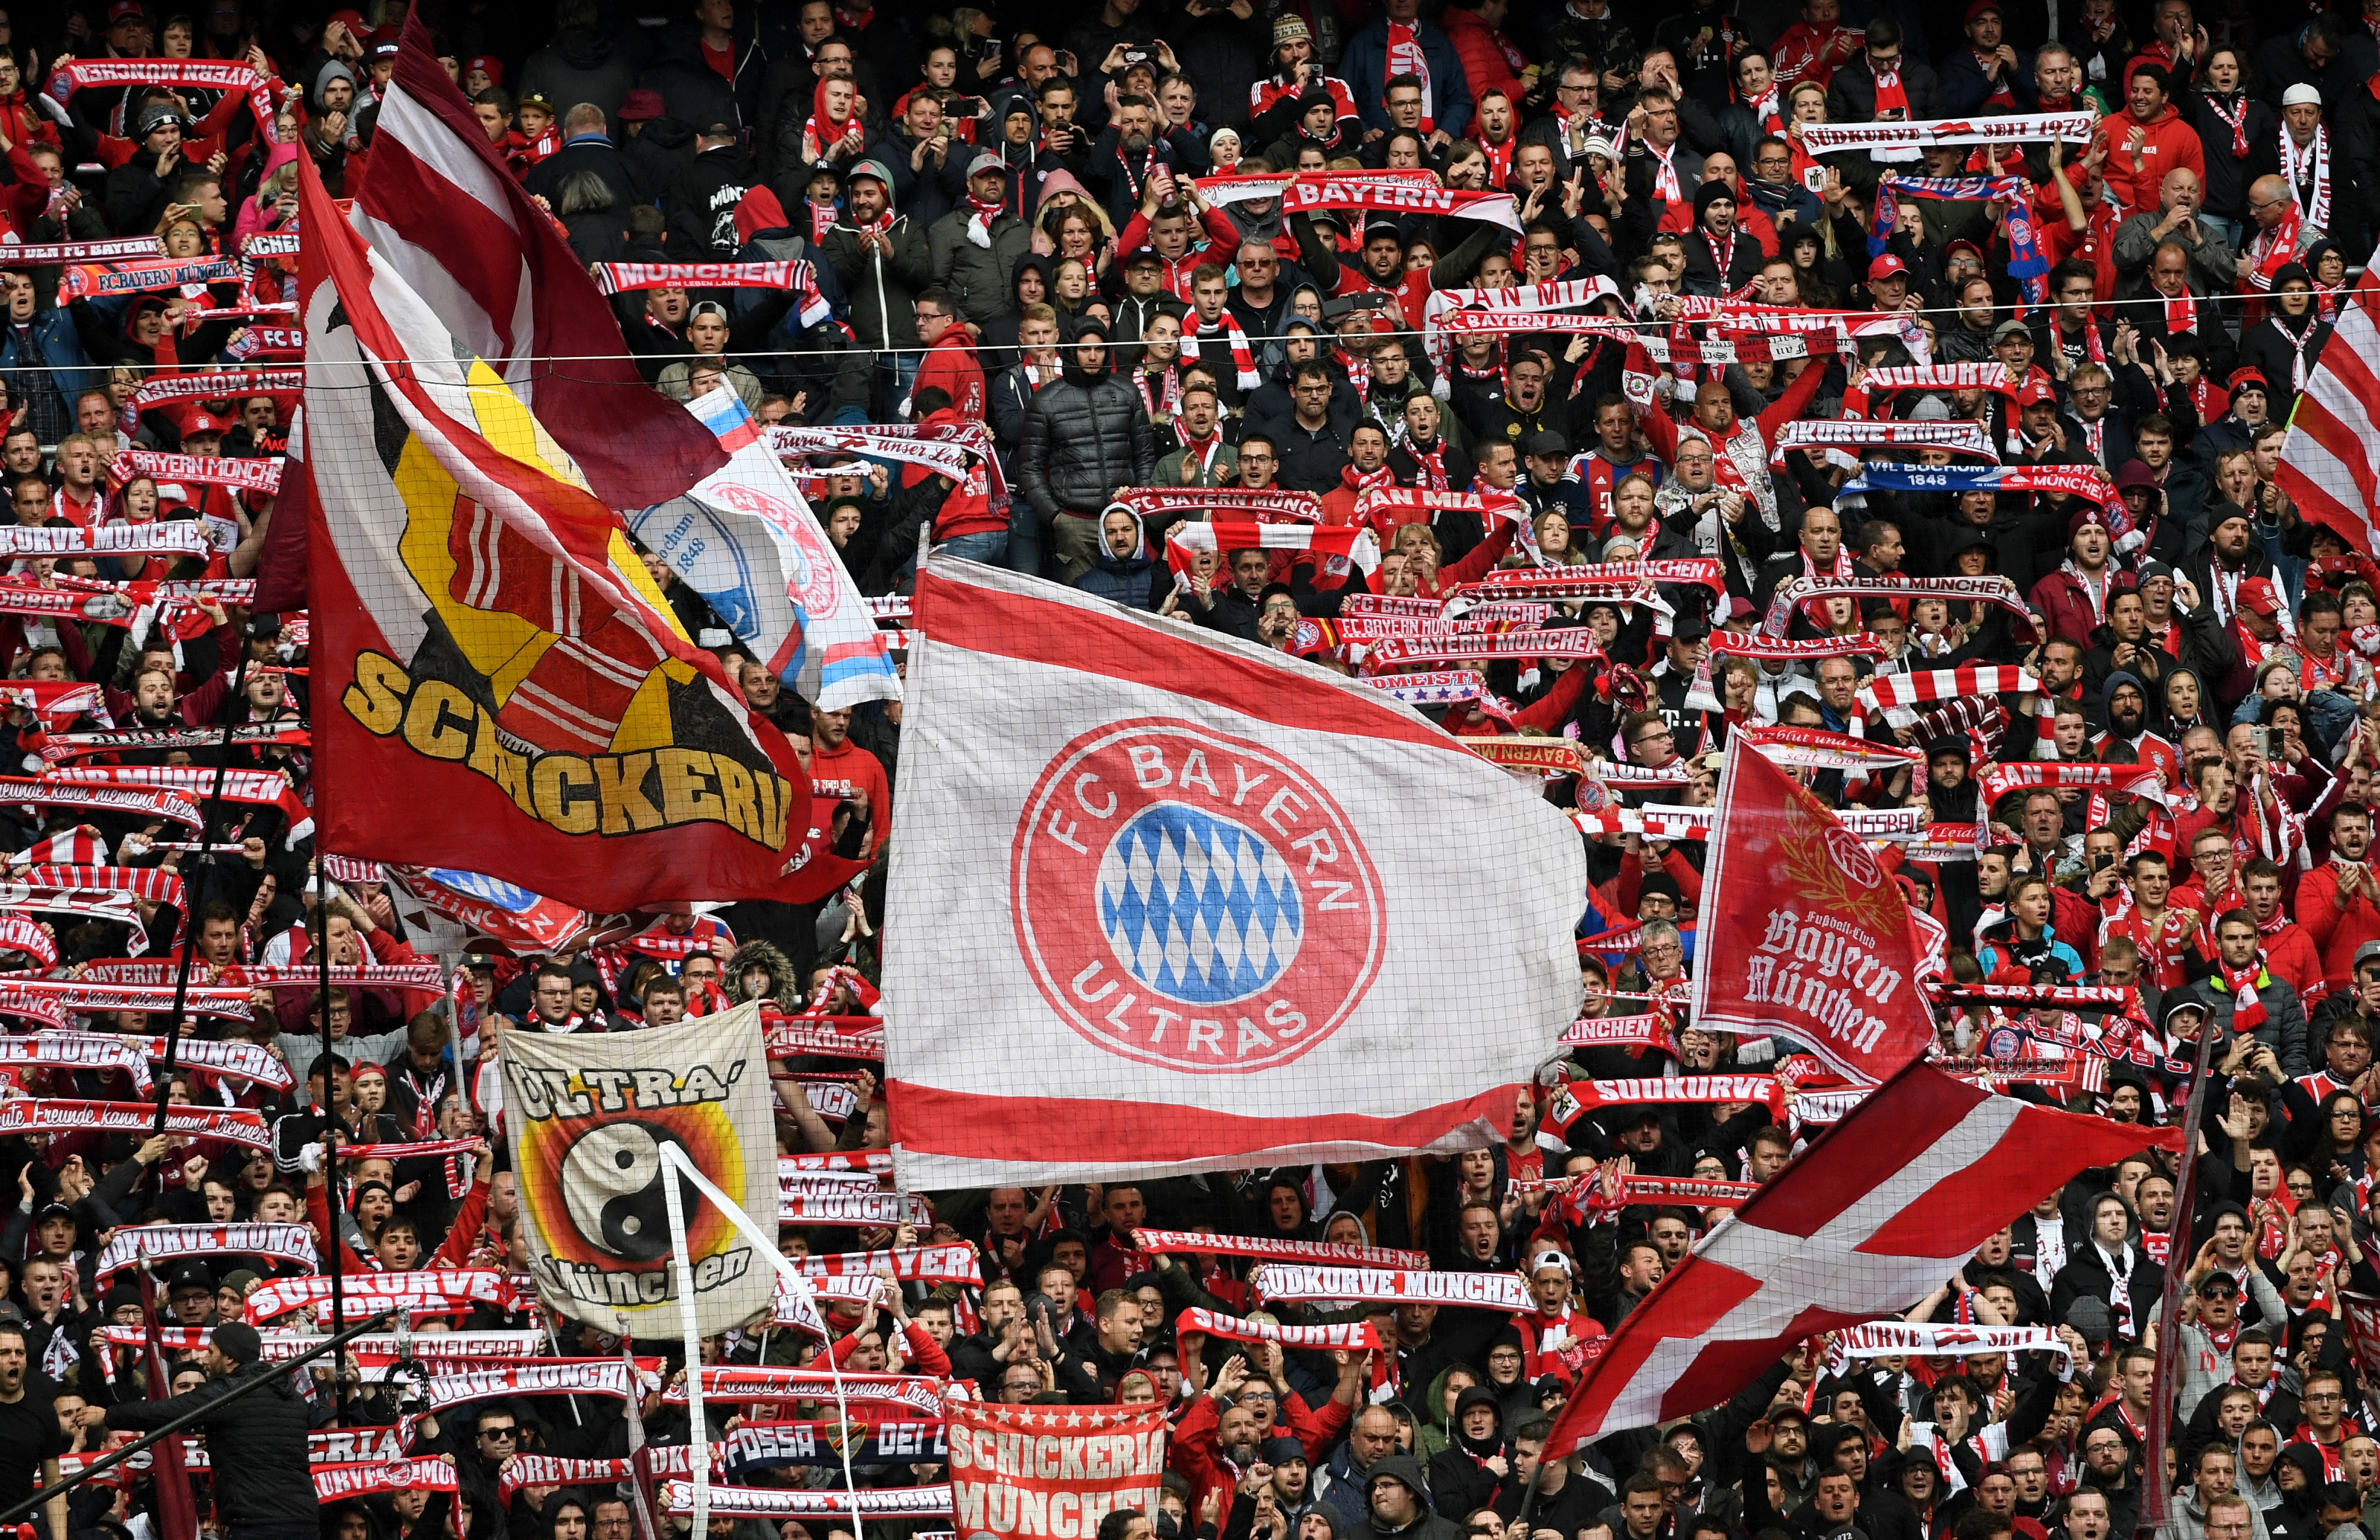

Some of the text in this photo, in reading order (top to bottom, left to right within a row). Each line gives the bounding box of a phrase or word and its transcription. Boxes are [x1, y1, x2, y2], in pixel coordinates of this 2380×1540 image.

[70, 63, 178, 84] MÜNCHEN
[1804, 126, 1920, 148] SÜDKURVE
[1982, 117, 2091, 138] SEIT 1972
[1200, 178, 1241, 202] ayern
[1296, 182, 1454, 209] BAYERN
[1440, 275, 1601, 308] SAN MIA
[1466, 312, 1556, 328] BAYERN
[1719, 312, 1848, 331] SAN MIA
[774, 431, 827, 450] Kurve
[132, 453, 203, 474] BAYERN
[1908, 474, 1946, 486] 1848
[1129, 492, 1322, 520] FC BAYERN MÜNCH
[1348, 489, 1483, 524] SAN MIA
[659, 511, 695, 560] ochum
[1698, 535, 1715, 550] 12
[675, 537, 707, 576] 1848
[1784, 578, 1807, 599] FC
[1812, 576, 1902, 589] BAYERN
[0, 591, 74, 610] OBBEN
[1351, 596, 1440, 617] FC BAYER
[1341, 620, 1360, 634] FC
[1360, 620, 1420, 634] BAYERN
[1374, 639, 1400, 660] FC
[1405, 635, 1490, 655] BAYERN
[1750, 729, 1847, 746] erzblut und
[1501, 744, 1565, 763] BAYERN
[1784, 751, 1818, 761] seit
[1988, 764, 2112, 789] SAN MIA
[50, 779, 90, 802] kann
[95, 785, 158, 809] niemand
[1046, 744, 1360, 912] FC BAYERN
[1757, 907, 1903, 1005] Bayern
[85, 989, 123, 1005] kann
[127, 990, 190, 1006] niemad
[1743, 954, 1888, 1054] München
[1983, 985, 2125, 1002] BAYERN
[1070, 959, 1308, 1057] ULTRAS
[2029, 1021, 2155, 1069] BAYER
[0, 1101, 25, 1127] ute
[33, 1099, 96, 1126] Freunde
[100, 1104, 141, 1128] kann
[147, 1108, 210, 1133] nemand
[713, 1369, 779, 1396] Freunde
[1874, 1370, 1888, 1382] NIKE
[727, 1425, 816, 1468] FOSSA
[878, 1423, 925, 1456] DEI
[948, 1424, 1164, 1481] SCHICKERIA
[673, 1483, 828, 1511] SDKURVE
